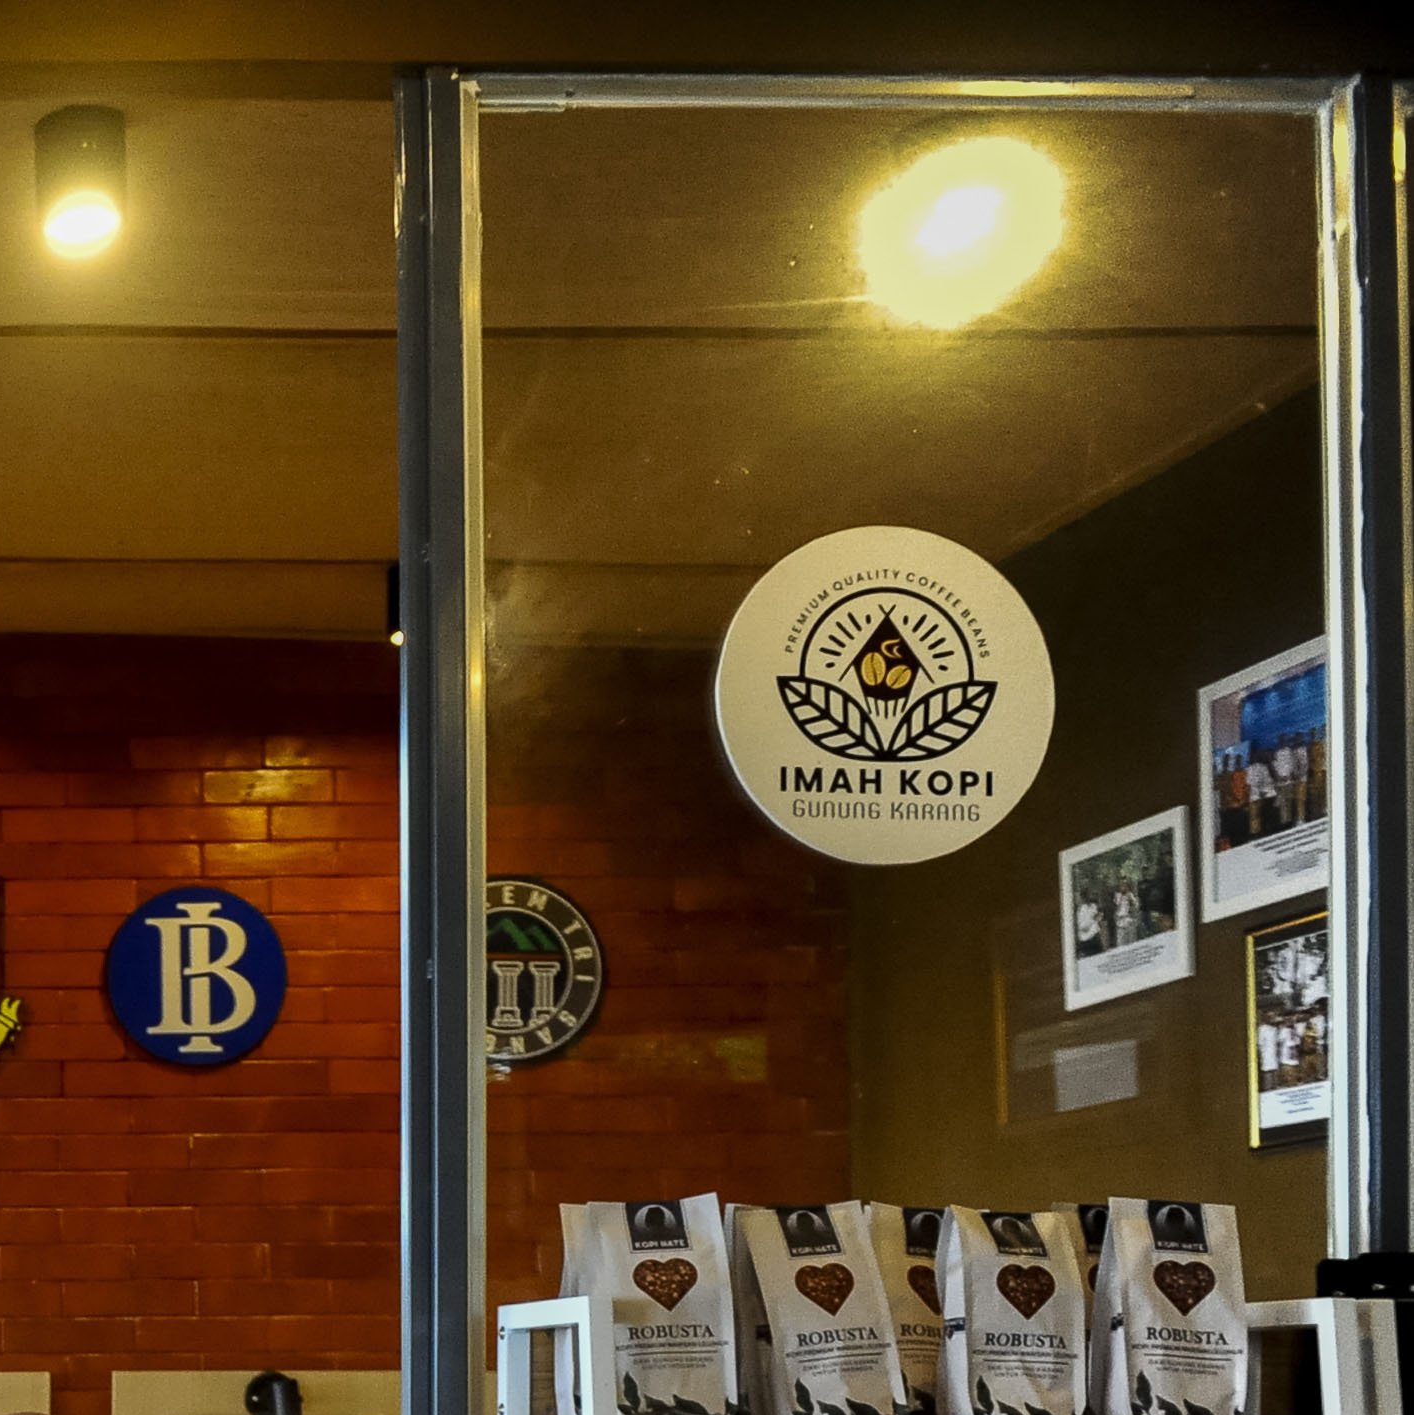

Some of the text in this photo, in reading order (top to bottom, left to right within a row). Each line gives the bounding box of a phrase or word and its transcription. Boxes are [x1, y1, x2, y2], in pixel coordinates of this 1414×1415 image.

[784, 568, 991, 659] PREMIUM QUALITY COFFEE BEANS
[779, 766, 994, 797] IMAH KOPI
[792, 798, 980, 822] GUNUNG KARANG
[563, 920, 596, 982] TRI
[628, 1325, 715, 1340] ROBUSTA
[796, 1327, 878, 1347] ROBUSTA
[984, 1333, 1067, 1349] ROBUSTA
[1146, 1327, 1228, 1345] ROBUSTA
